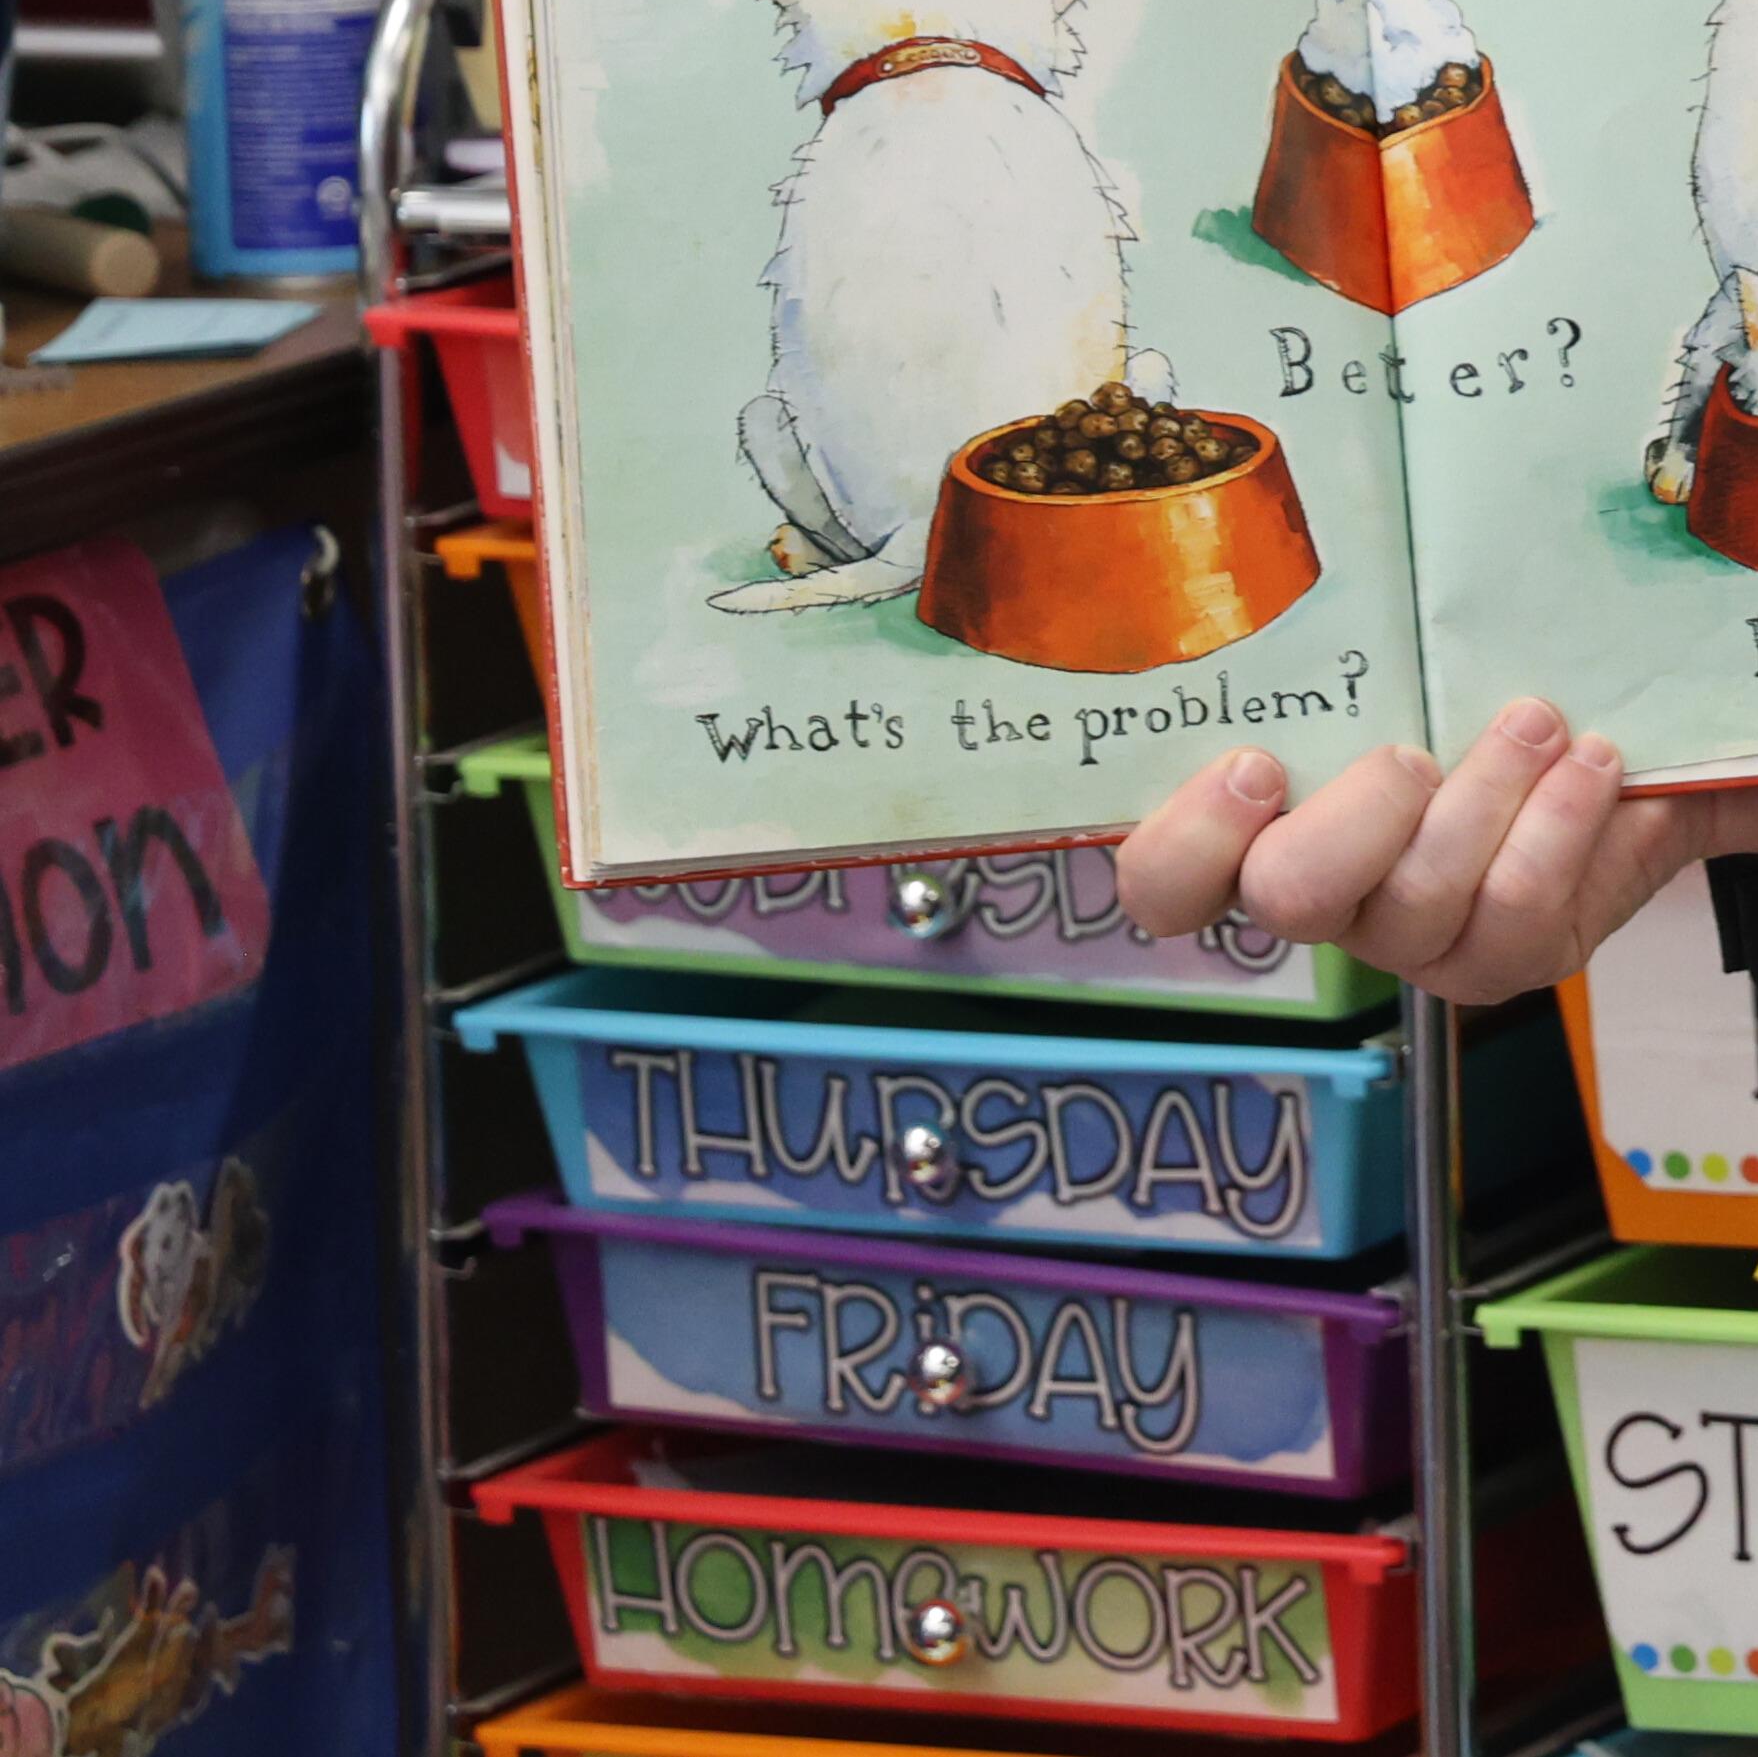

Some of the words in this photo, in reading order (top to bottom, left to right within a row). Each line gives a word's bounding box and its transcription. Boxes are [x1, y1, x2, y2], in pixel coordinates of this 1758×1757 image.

[696, 701, 906, 764] What's
[950, 698, 1051, 752] the
[1078, 649, 1370, 766] problem?
[610, 1049, 1310, 1238] THURSDAY
